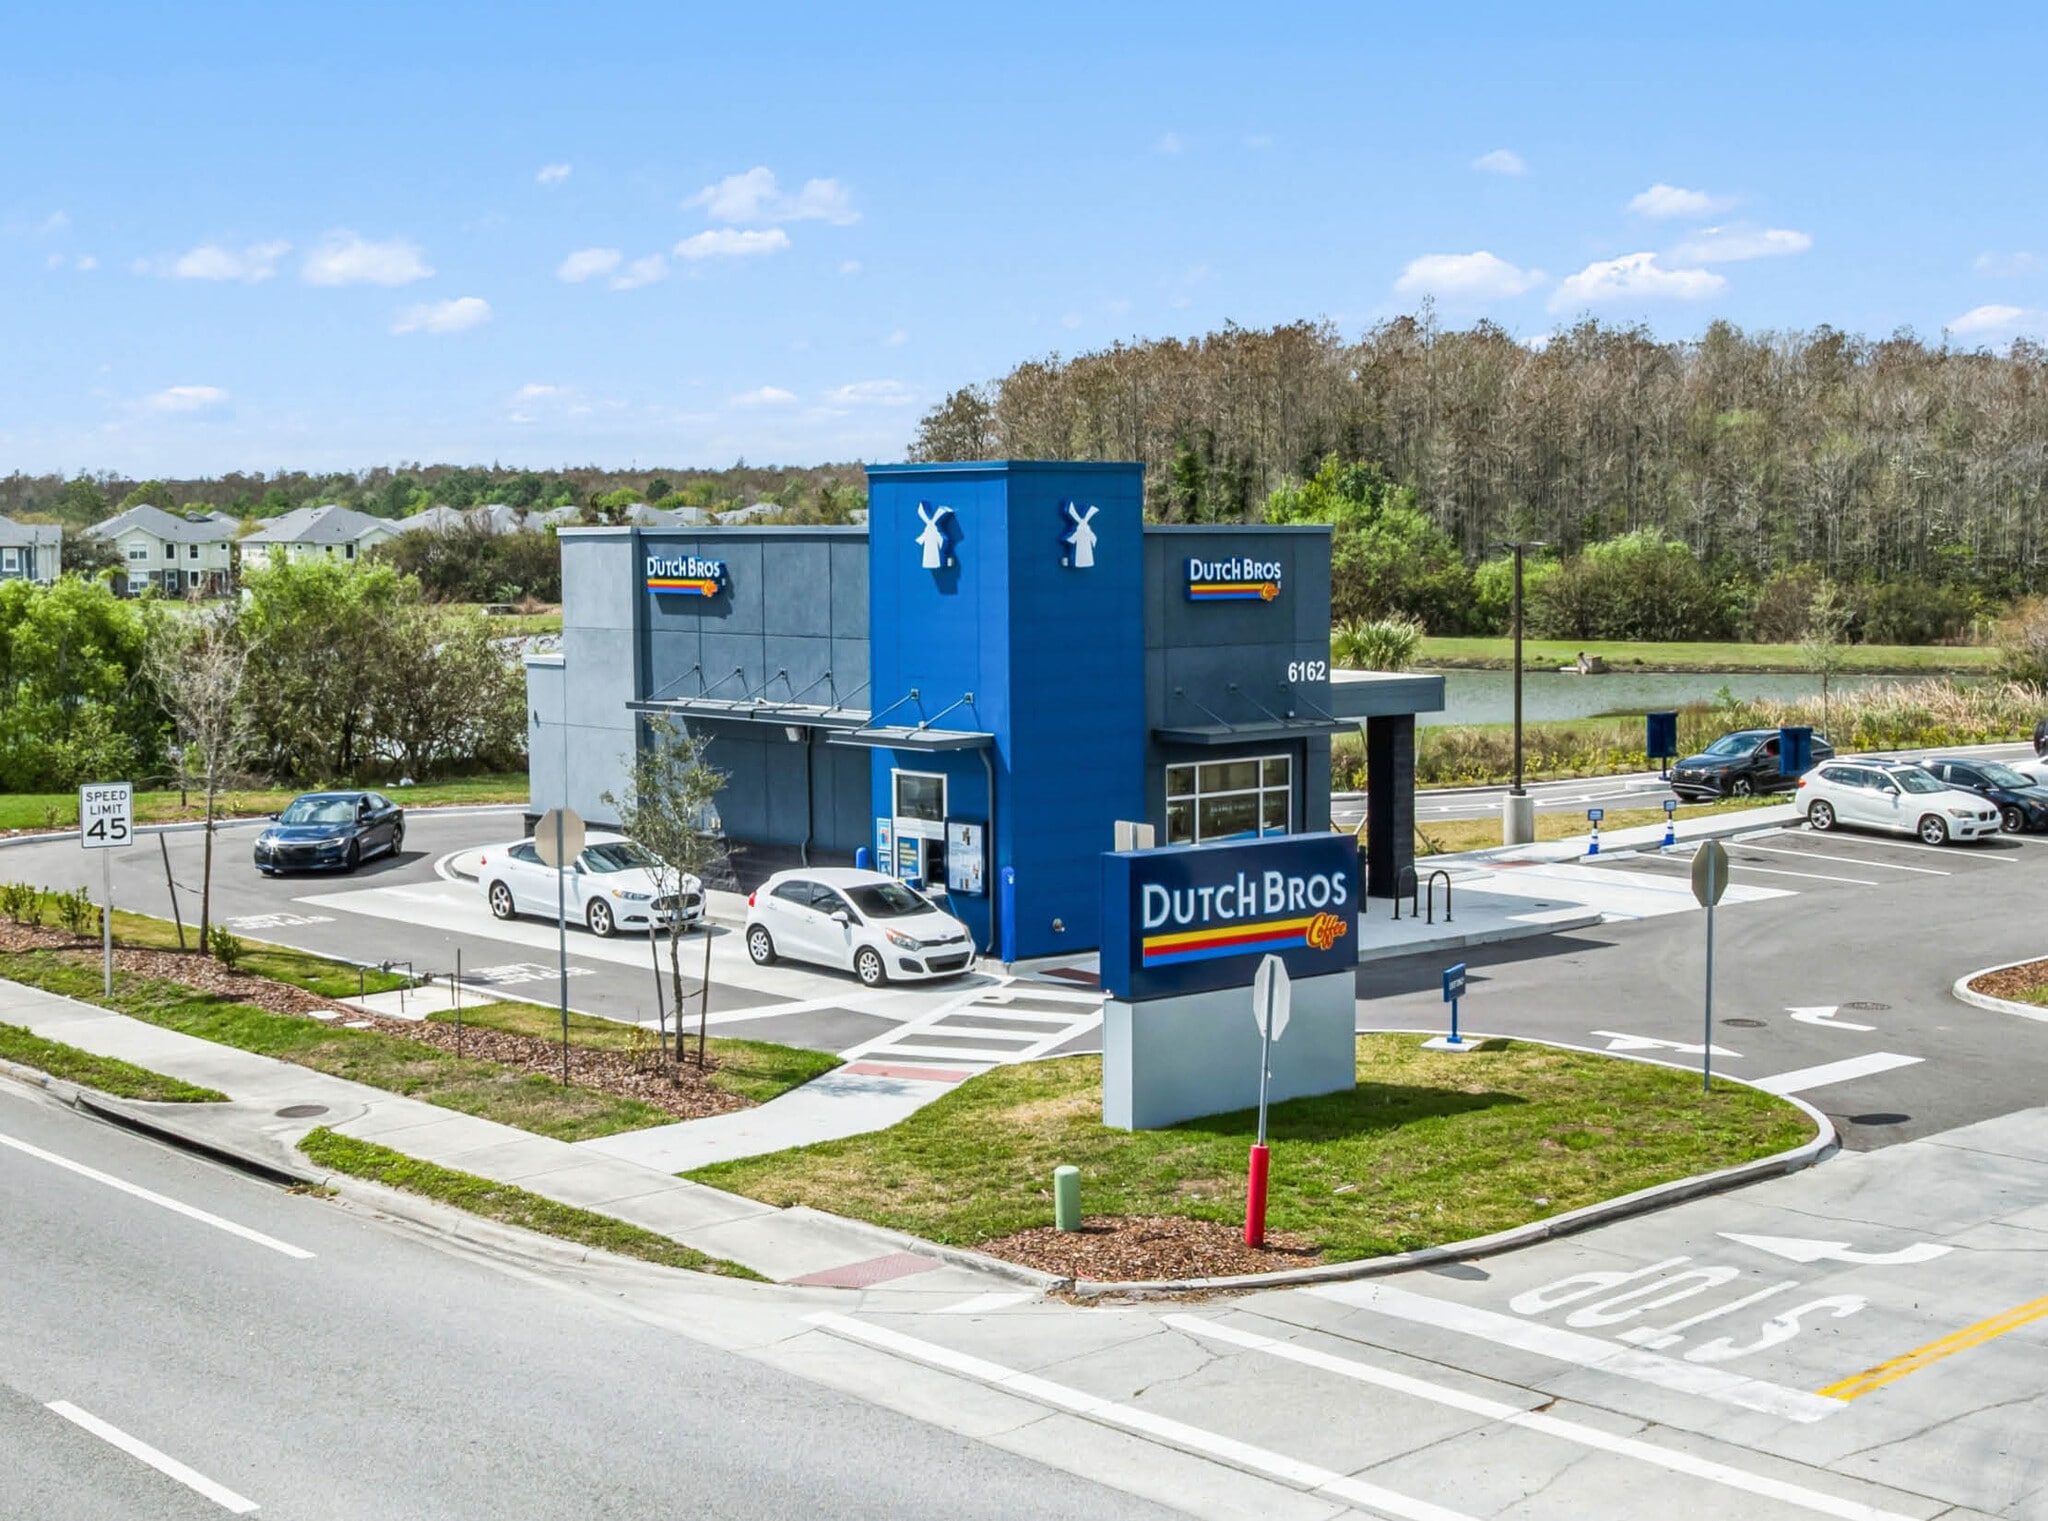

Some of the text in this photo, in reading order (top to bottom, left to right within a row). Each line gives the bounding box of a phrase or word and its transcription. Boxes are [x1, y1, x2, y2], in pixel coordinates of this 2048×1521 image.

[688, 557, 720, 577] BROS
[1244, 558, 1281, 580] BROS
[1288, 661, 1326, 682] 6162
[86, 790, 127, 802] SPEED
[90, 804, 122, 815] LIMIT
[87, 818, 127, 840] 45
[1264, 871, 1347, 914] BROS
[1306, 912, 1347, 950] Coffee
[1509, 1255, 1868, 1362] STOP
